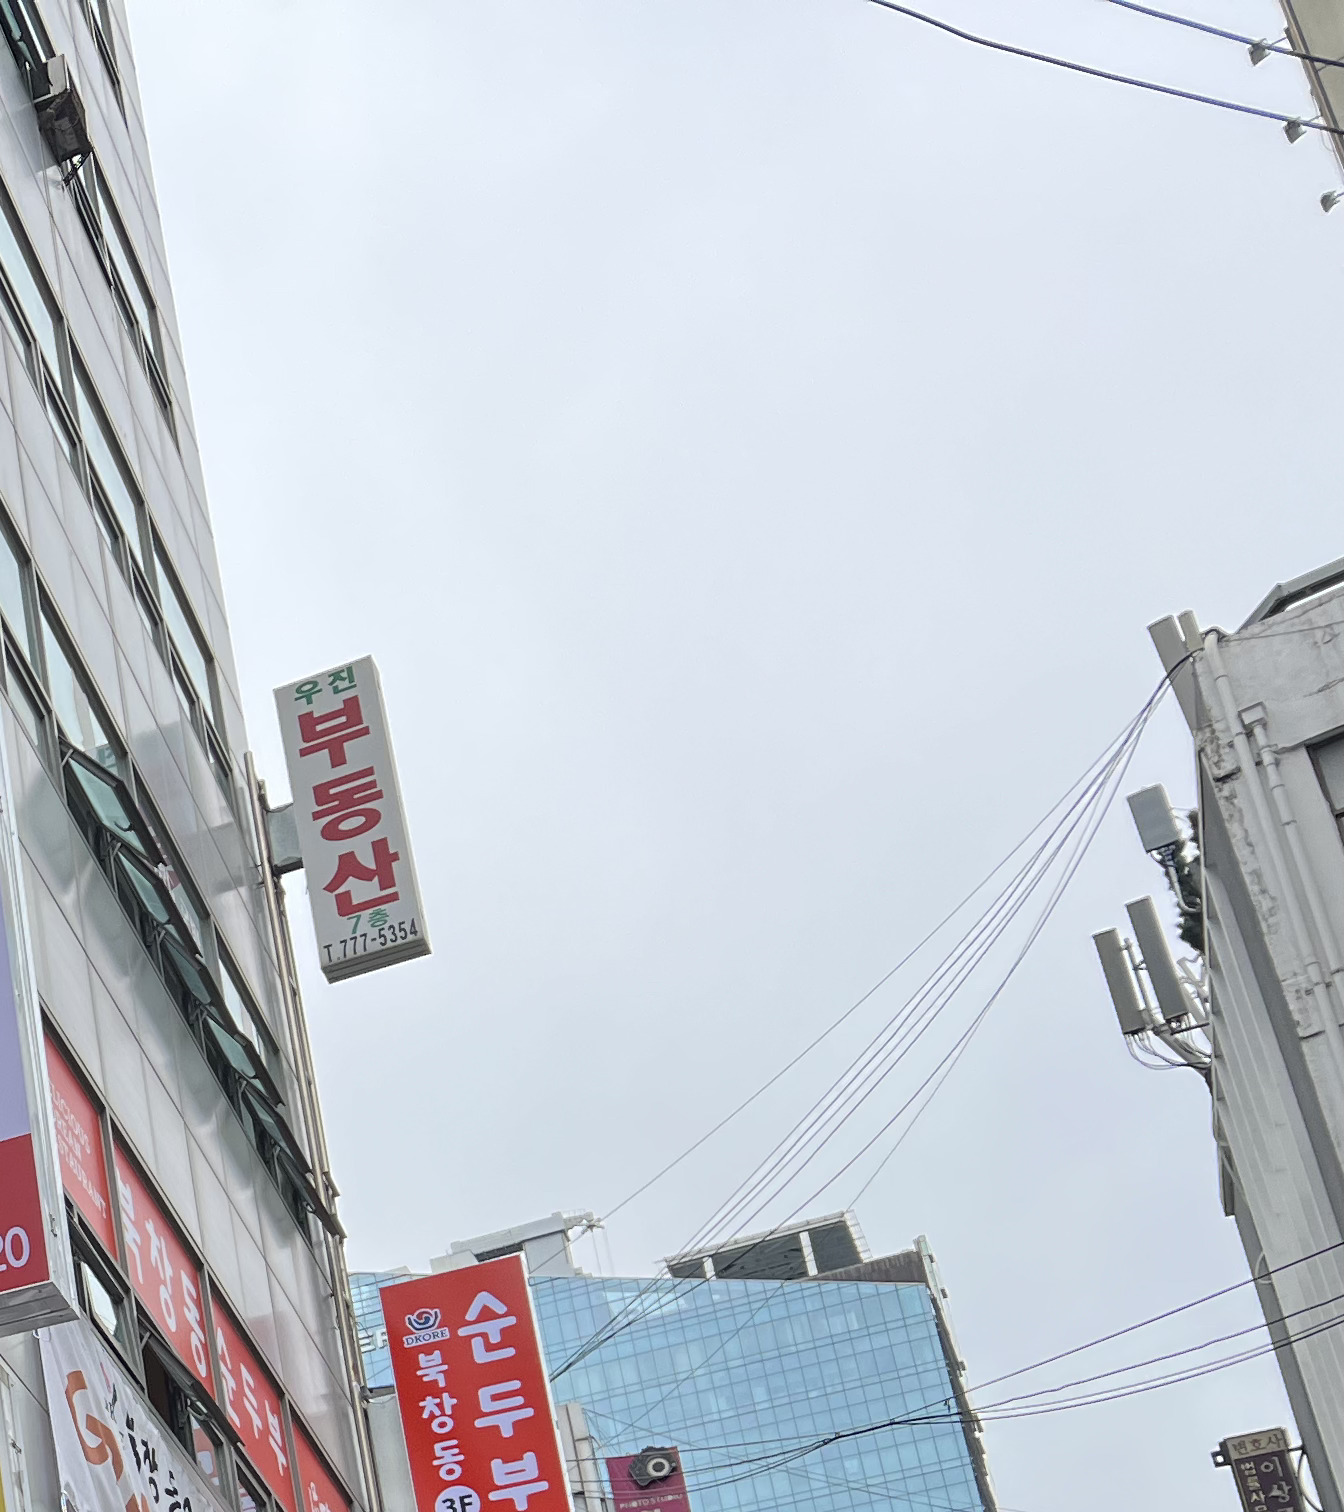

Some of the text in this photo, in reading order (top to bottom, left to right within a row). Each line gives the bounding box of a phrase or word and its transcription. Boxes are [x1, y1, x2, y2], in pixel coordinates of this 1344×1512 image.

[294, 665, 358, 705] 우진
[297, 695, 401, 918] 부동산
[323, 918, 419, 963] T.777-5354
[216, 1326, 288, 1477] 순두부
[416, 1349, 466, 1482] 북창동
[457, 1291, 549, 1512] 순두부
[1232, 1433, 1283, 1456] 변호사
